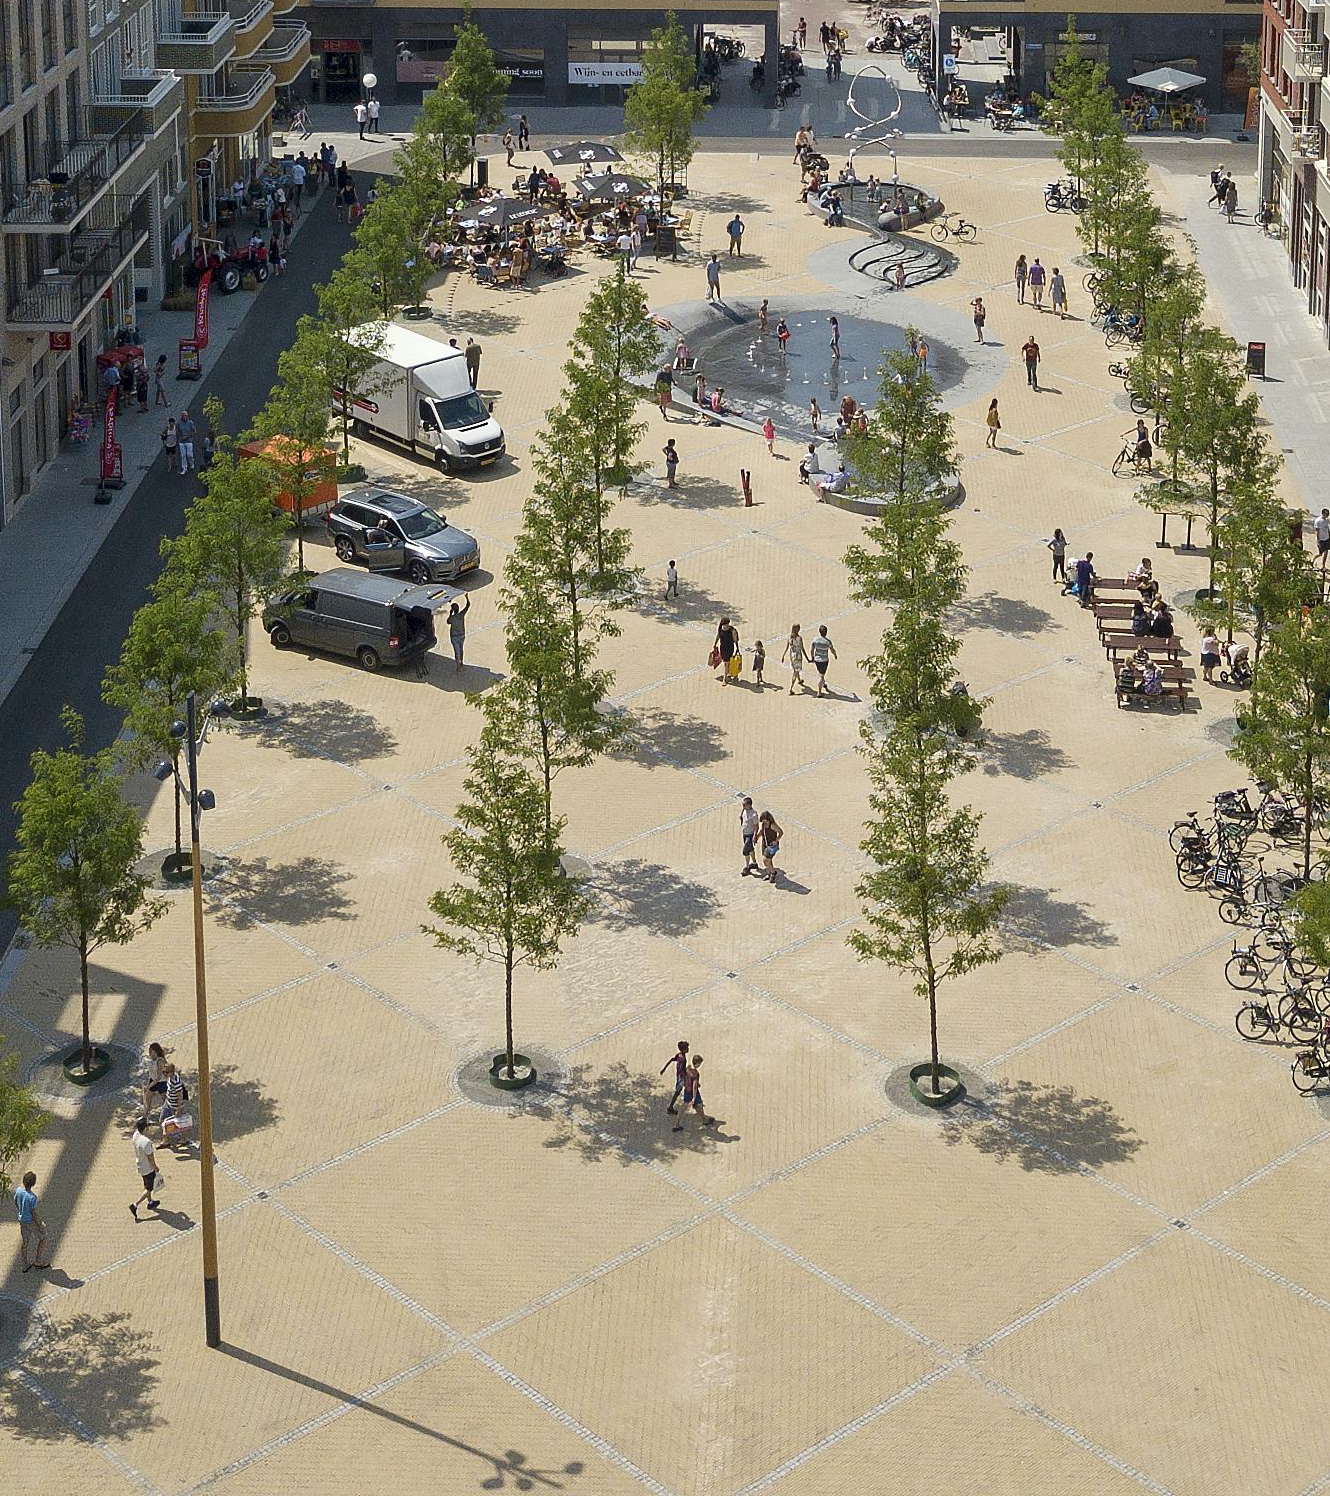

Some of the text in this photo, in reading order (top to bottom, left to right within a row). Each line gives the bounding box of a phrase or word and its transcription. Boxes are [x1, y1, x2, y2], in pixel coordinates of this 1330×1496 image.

[521, 68, 543, 76] soon
[574, 67, 643, 77] Wijn- en eetbar
